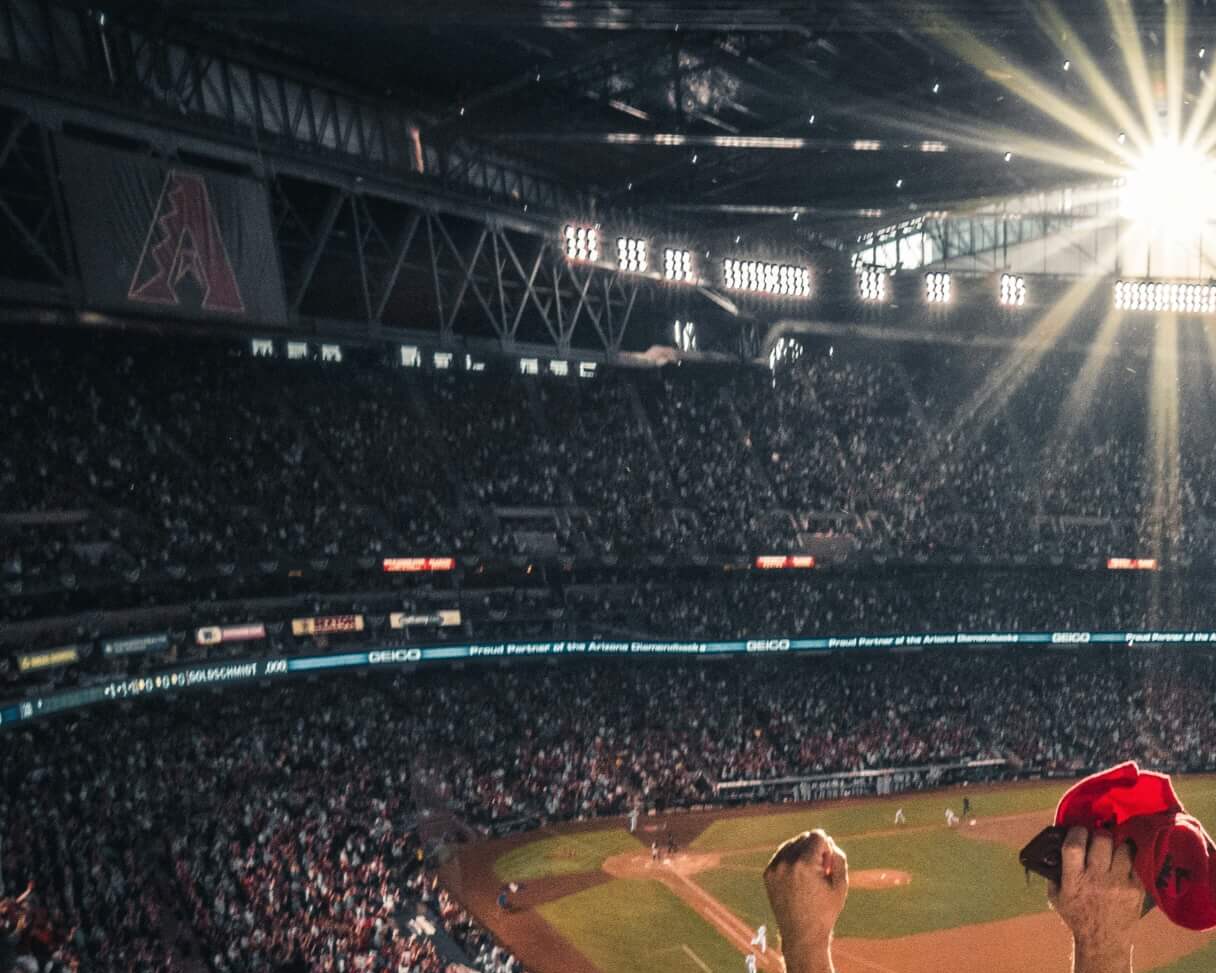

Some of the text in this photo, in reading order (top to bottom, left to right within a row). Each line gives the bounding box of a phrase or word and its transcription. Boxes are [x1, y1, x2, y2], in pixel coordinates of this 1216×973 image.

[1052, 632, 1090, 643] GEICO
[470, 644, 504, 656] Proud
[507, 643, 550, 655] Partner
[747, 639, 790, 651] GEICO
[368, 648, 421, 664] GEICO
